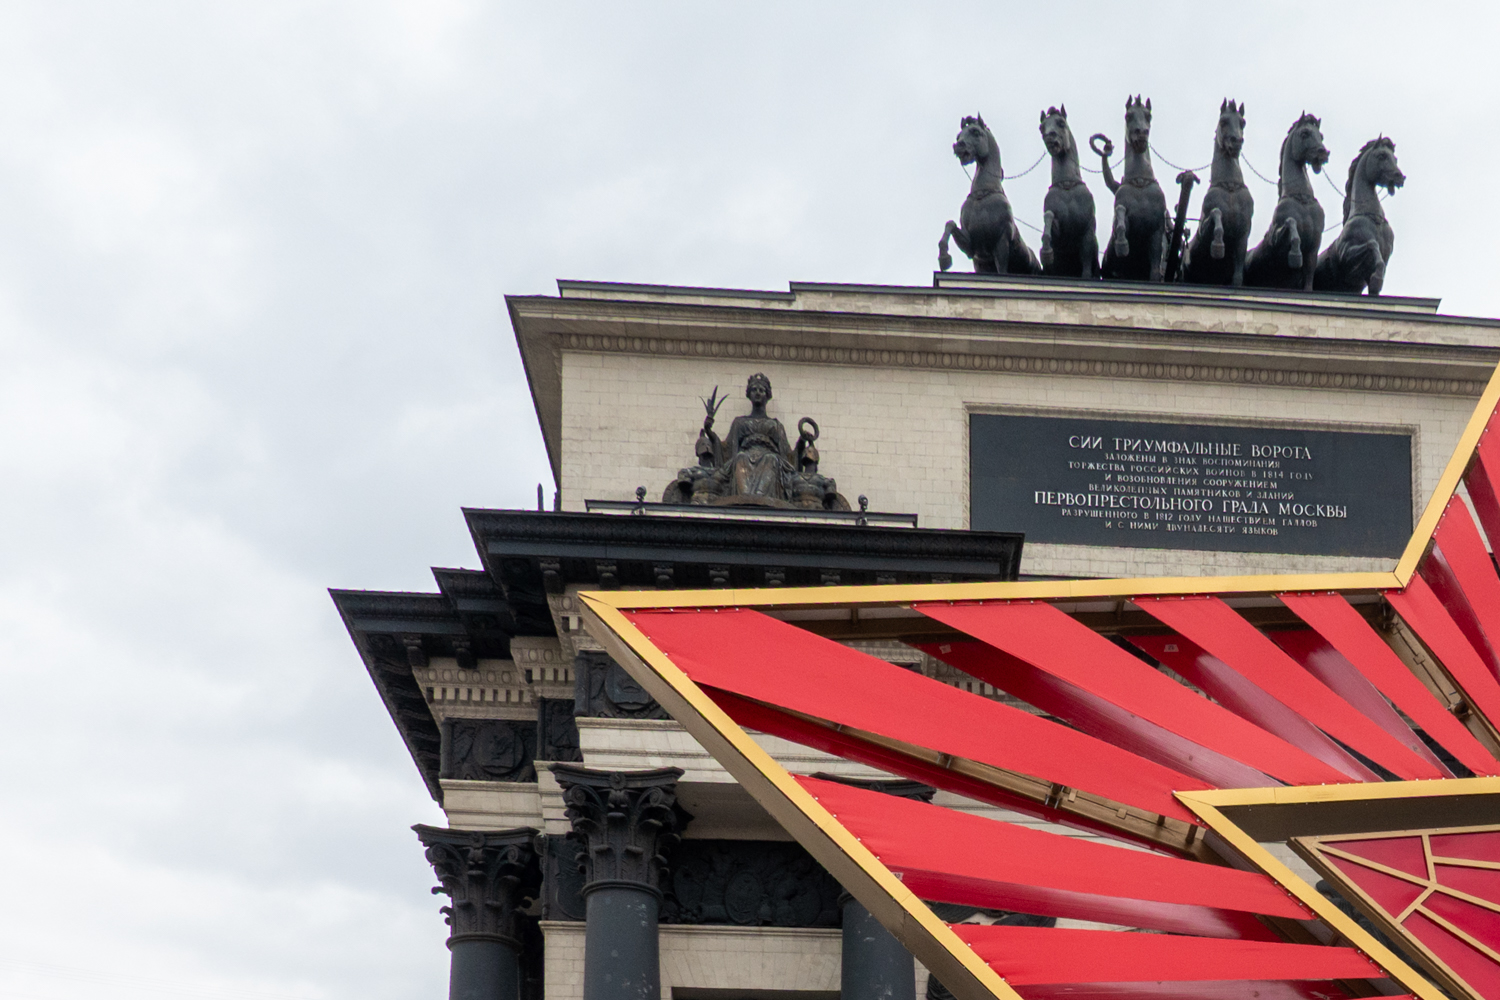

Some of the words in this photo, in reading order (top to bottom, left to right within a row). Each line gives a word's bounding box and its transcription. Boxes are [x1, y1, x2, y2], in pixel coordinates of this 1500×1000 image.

[1069, 436, 1102, 449] СИИ
[1112, 437, 1243, 457] ТРИУМФАЛЬНЫЕ
[1251, 444, 1312, 459] ВОРОТА
[1105, 453, 1156, 463] ЗАЛОЖЕНЫ
[1174, 457, 1197, 465] ЗНАК
[1203, 458, 1280, 468] ВОСПОМИНАНИЯ
[1068, 461, 1125, 472] ТОРЖЕСТВА
[1130, 465, 1199, 475] РОССИЙСКИХ
[1252, 470, 1257, 478] В
[1263, 470, 1284, 479] 1814
[1105, 473, 1111, 481] И
[1117, 474, 1197, 486] ВОЗОБНОВЛЕНИЯ
[1203, 478, 1278, 489] СООРУЖЕНИЕМ
[1174, 488, 1240, 498] ПАМЯТНИКОВ
[1246, 490, 1253, 498] И
[1034, 491, 1213, 512] ПЕРВОПРЕСТОЛЬНОГО
[1222, 500, 1269, 515] ГРАДА
[1278, 502, 1347, 519] МОСКВЫ
[1062, 508, 1138, 520] РАЗРУШЕННОГО
[1144, 512, 1150, 520] В
[1155, 513, 1173, 521] 1812
[1179, 514, 1202, 523] ГОДУ
[1209, 515, 1276, 526] НАШЕСТВИЕМ
[1105, 521, 1112, 529] И
[1118, 521, 1124, 529] С
[1130, 522, 1159, 531] НИМИ
[1242, 527, 1278, 536] ЯЗЫКОВ
